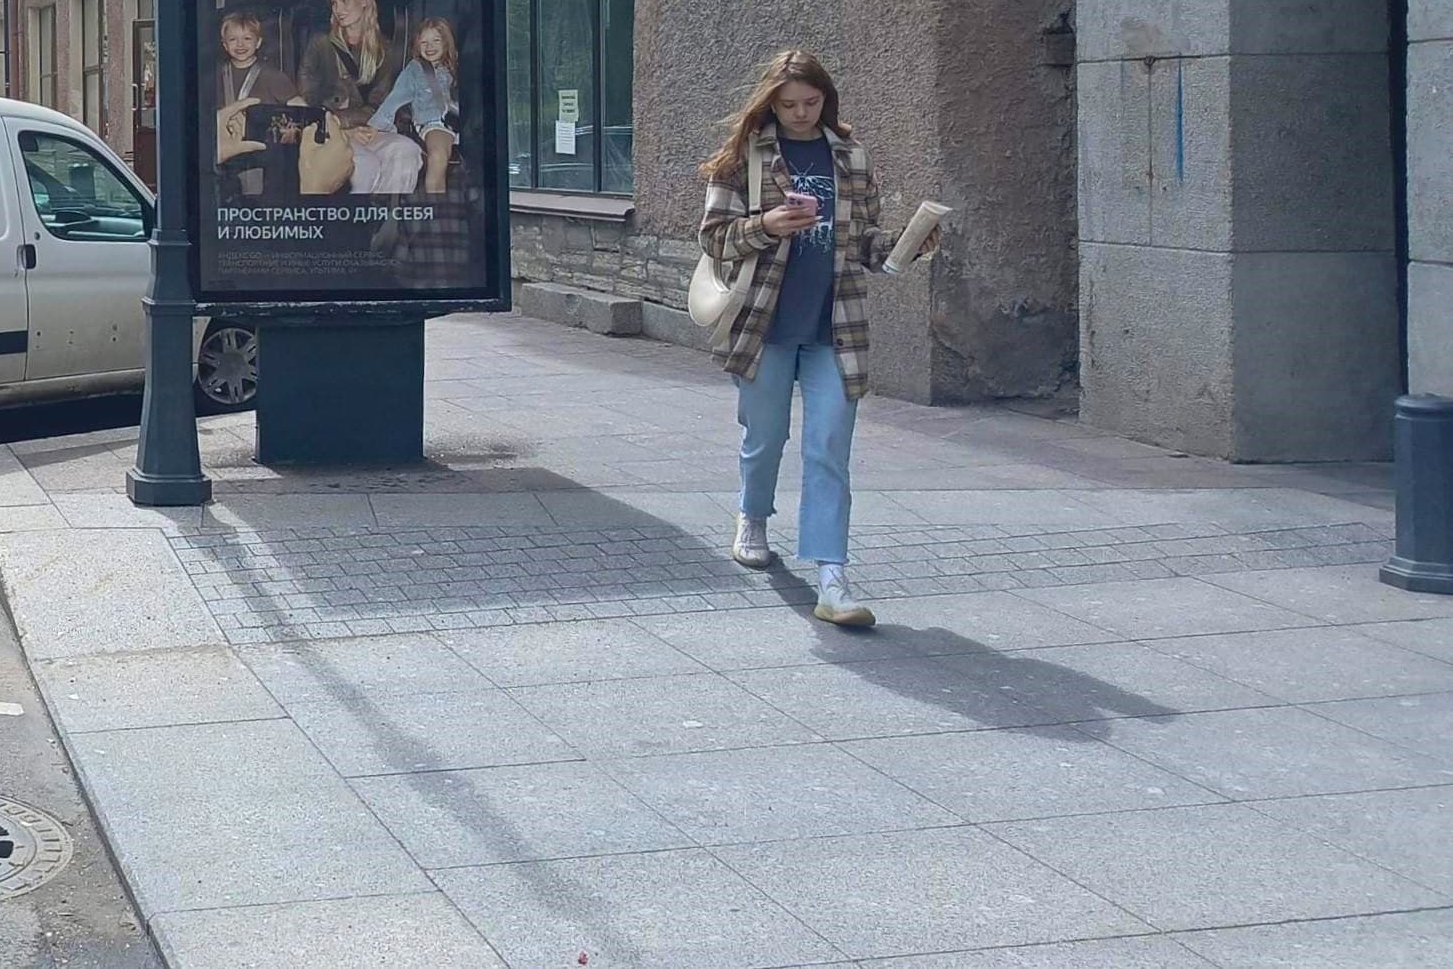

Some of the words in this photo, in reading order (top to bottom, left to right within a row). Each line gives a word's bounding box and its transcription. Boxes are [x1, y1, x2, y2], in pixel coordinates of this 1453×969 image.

[217, 207, 350, 221] ПРОСТРАНСТВО
[353, 206, 388, 223] ДЛЯ
[392, 206, 434, 221] СЕБЯ
[218, 227, 230, 239] И
[233, 226, 324, 239] ЛЮБИМЫХ
